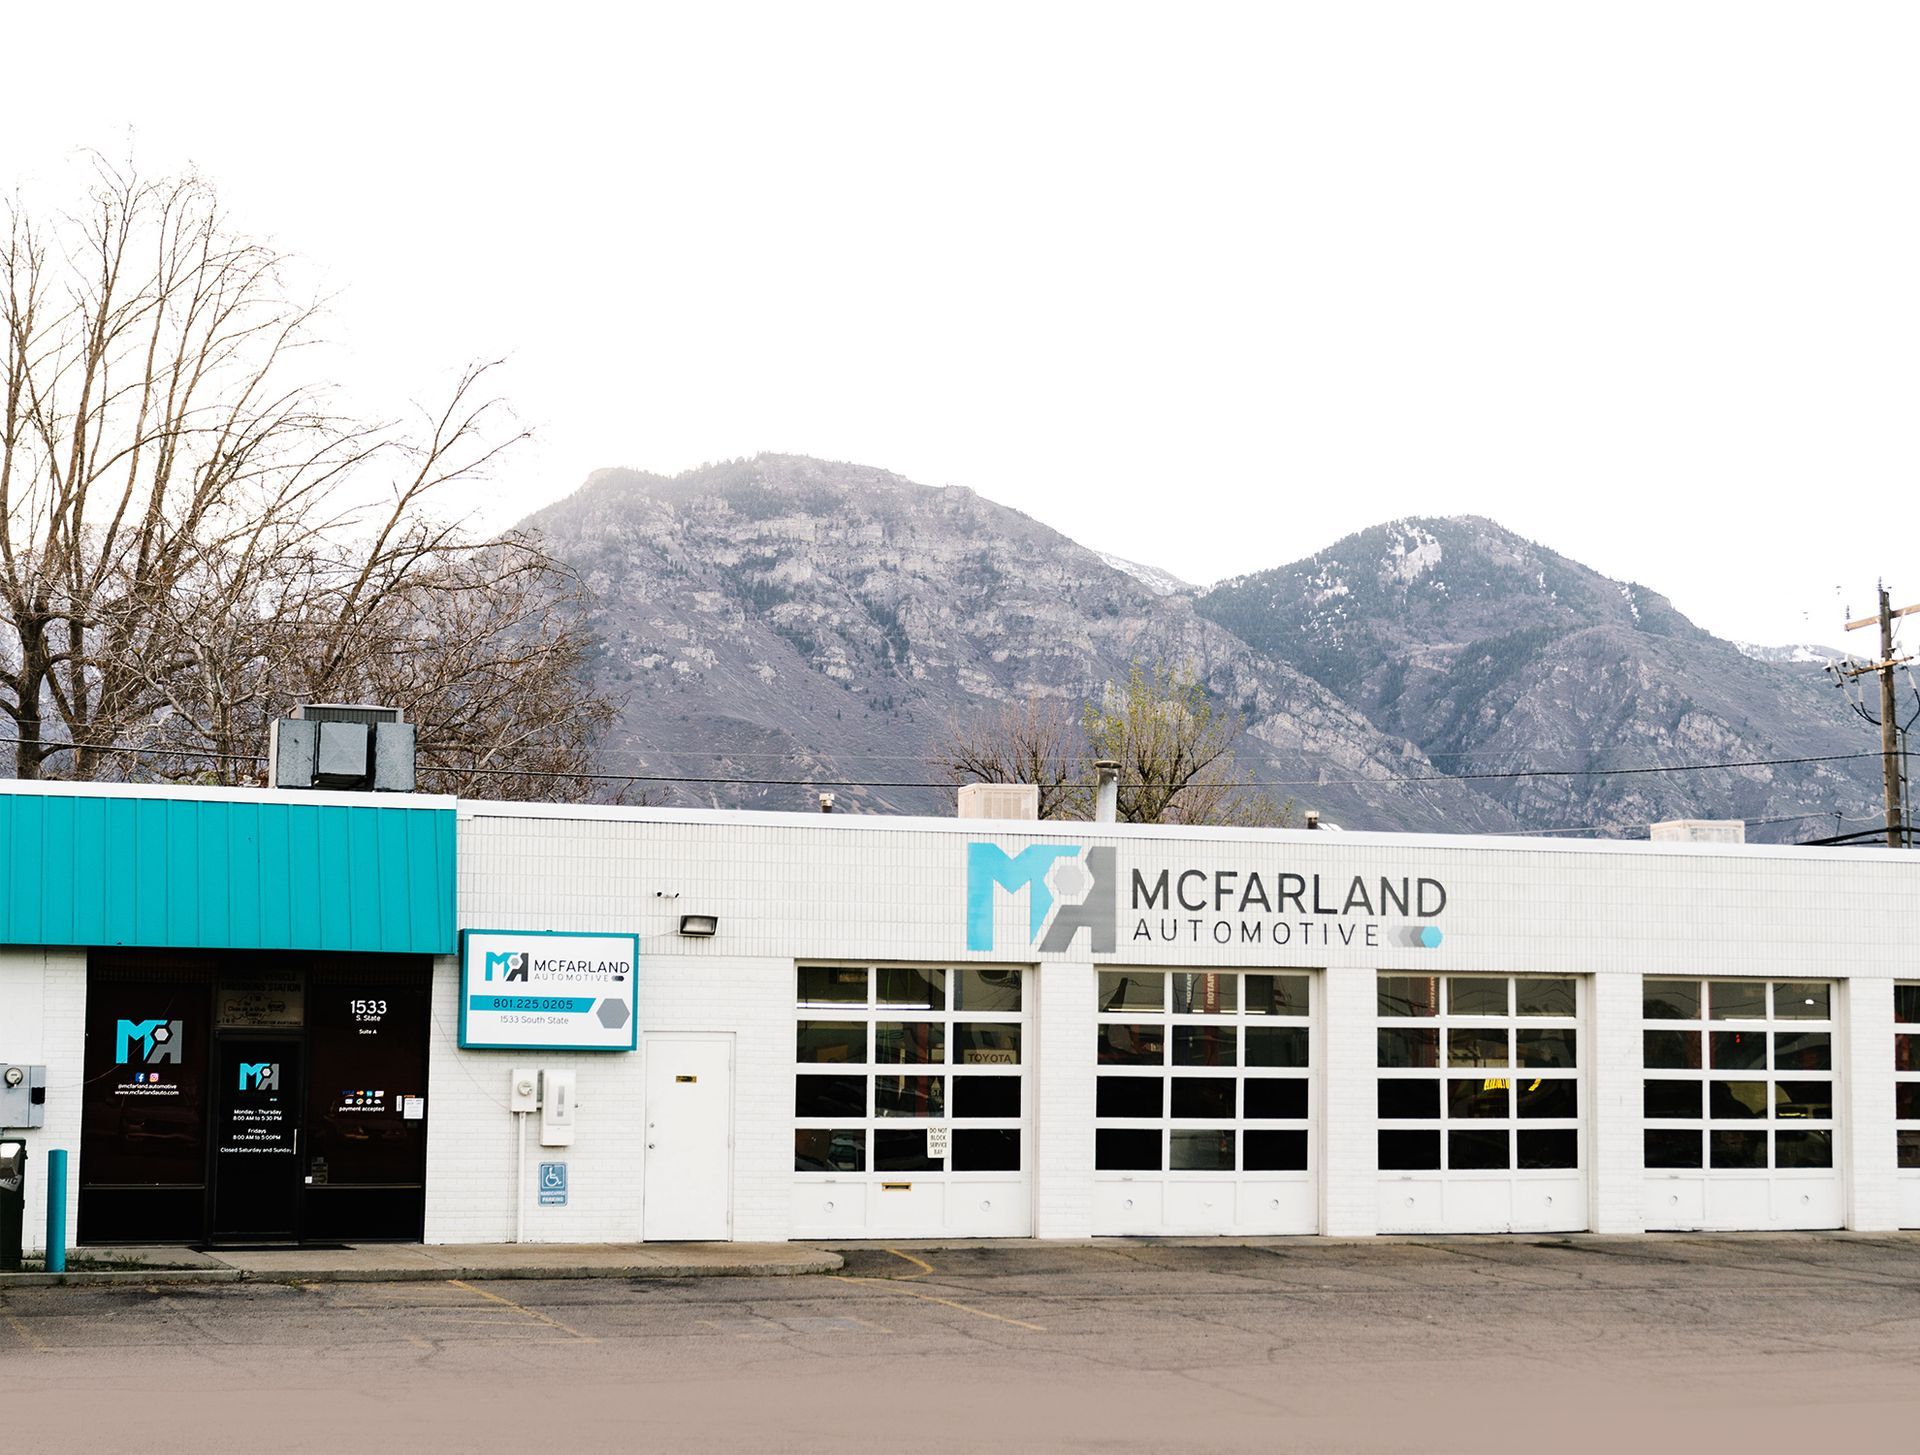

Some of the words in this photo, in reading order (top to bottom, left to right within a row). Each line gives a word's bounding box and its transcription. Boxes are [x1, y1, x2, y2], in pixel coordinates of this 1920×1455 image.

[1132, 868, 1447, 918] MCFARLAND
[1133, 918, 1379, 947] AUTOMOTIVE
[534, 960, 630, 974] MCFARLAND
[534, 973, 609, 982] AUTOMOTIVE
[350, 1000, 387, 1014] 1533
[493, 998, 573, 1010] 801.225.0205
[500, 1015, 518, 1024] 1533
[521, 1016, 545, 1024] South
[547, 1016, 569, 1025] State
[968, 1054, 1013, 1064] TOYOTA
